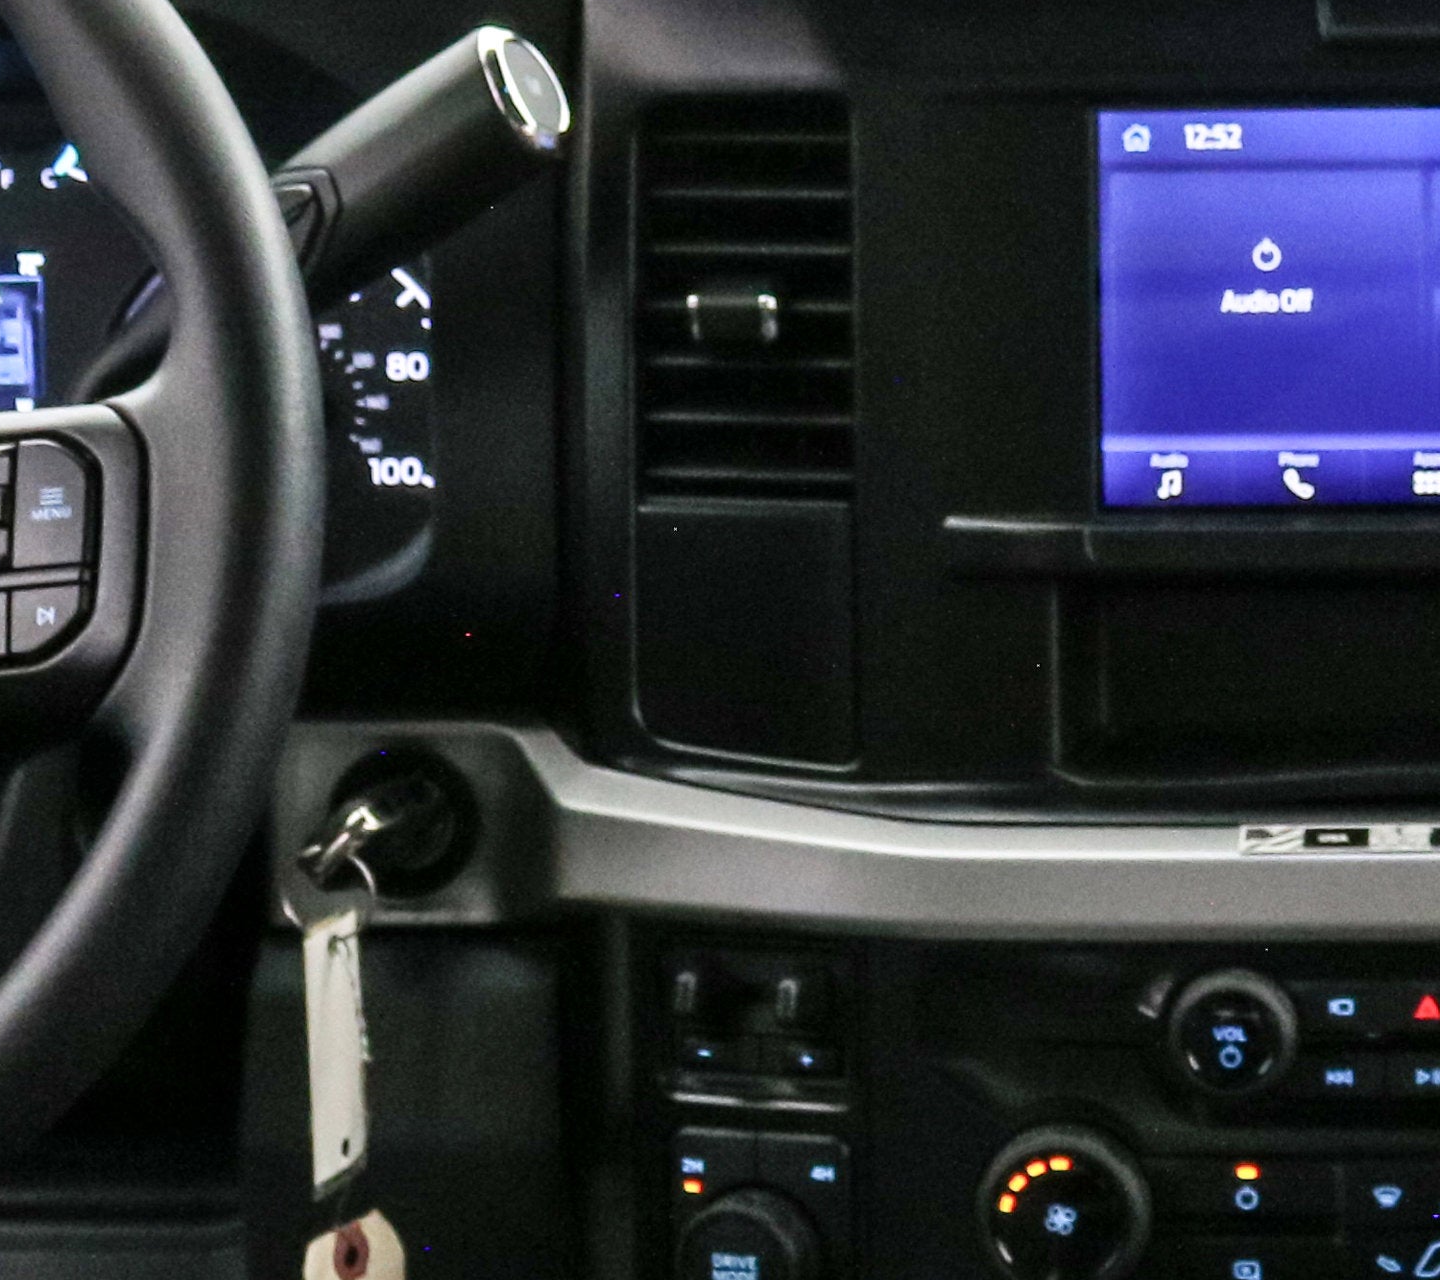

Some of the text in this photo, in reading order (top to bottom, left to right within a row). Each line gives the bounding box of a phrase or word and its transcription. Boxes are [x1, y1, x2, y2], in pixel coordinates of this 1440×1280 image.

[1182, 122, 1243, 151] 12:52
[1219, 288, 1314, 315] Audio Off
[385, 350, 430, 382] 80
[366, 456, 424, 487] 100
[30, 505, 73, 521] MENU
[1212, 1026, 1249, 1043] VOL
[711, 1252, 758, 1270] DRIVE
